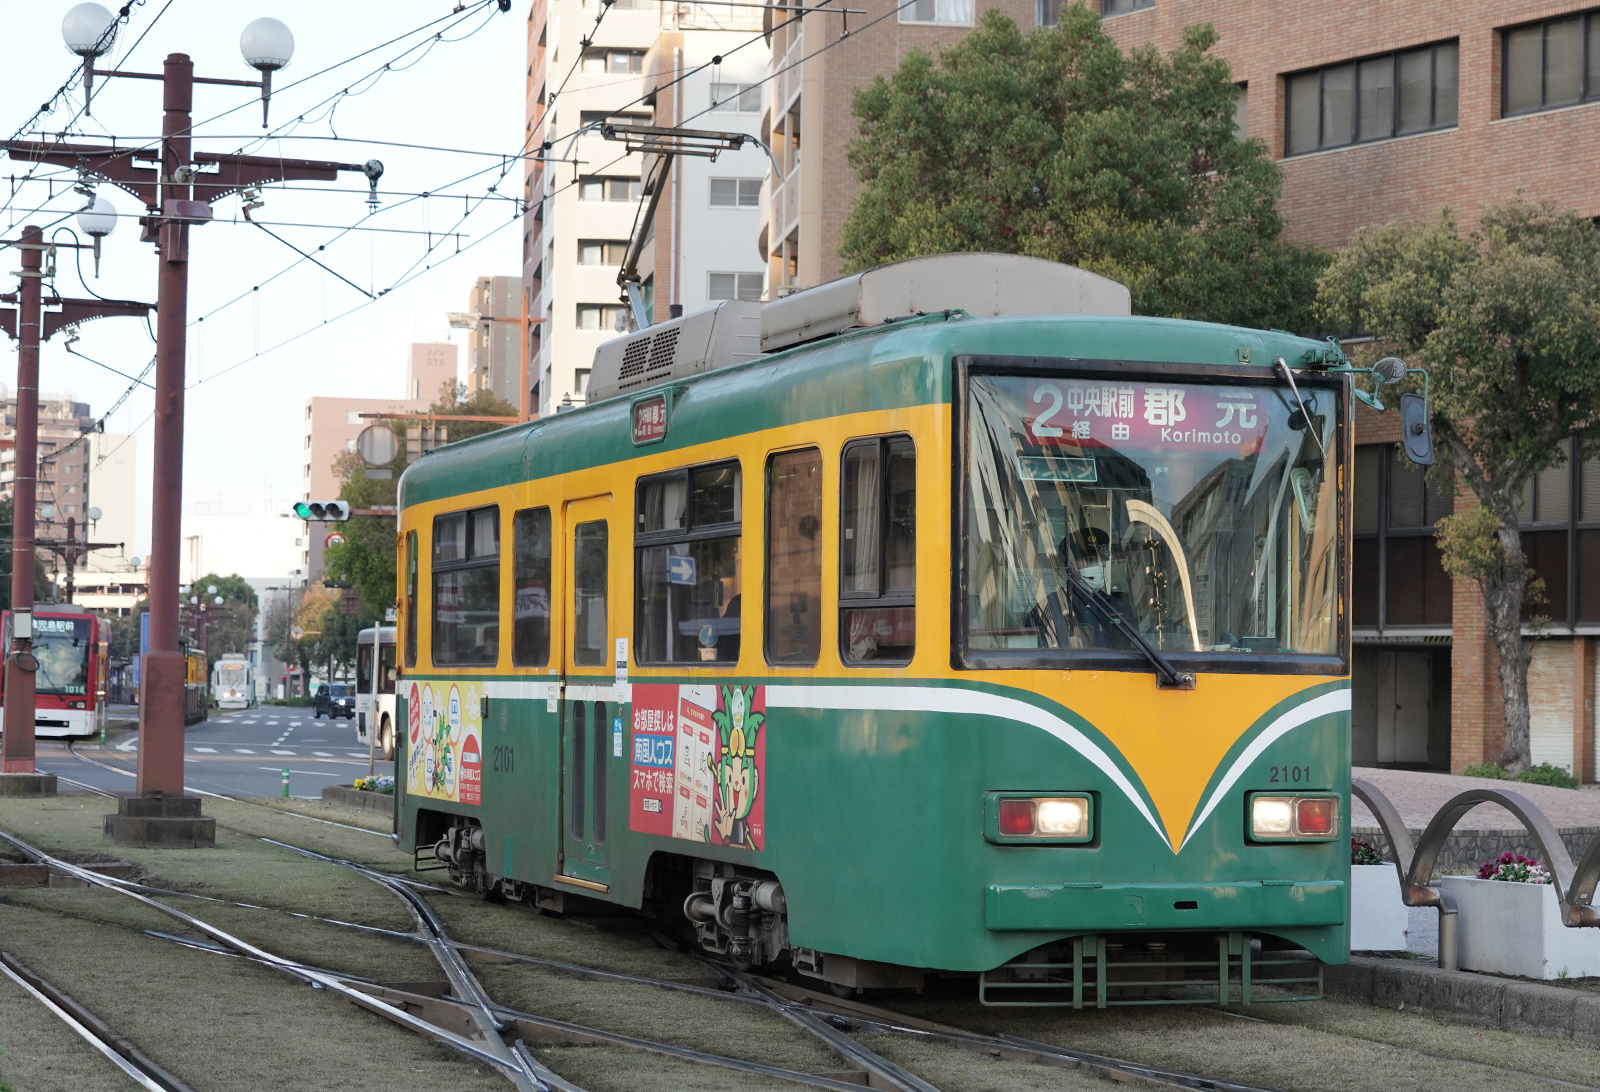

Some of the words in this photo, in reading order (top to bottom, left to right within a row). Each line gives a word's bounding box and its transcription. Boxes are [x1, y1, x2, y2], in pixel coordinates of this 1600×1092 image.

[637, 408, 643, 436] 2
[1031, 384, 1063, 437] 2
[1067, 385, 1135, 418] 中央駅前
[1143, 387, 1257, 429] 郡元
[1072, 420, 1130, 440] 経由
[1161, 427, 1241, 445] Korimoto
[65, 685, 85, 694] 1014
[634, 708, 674, 732] お部屋探しは
[493, 745, 514, 773] 2101
[634, 737, 673, 765] 南国ハウス
[633, 769, 673, 794] スマホで検索
[1269, 765, 1310, 783] 2101
